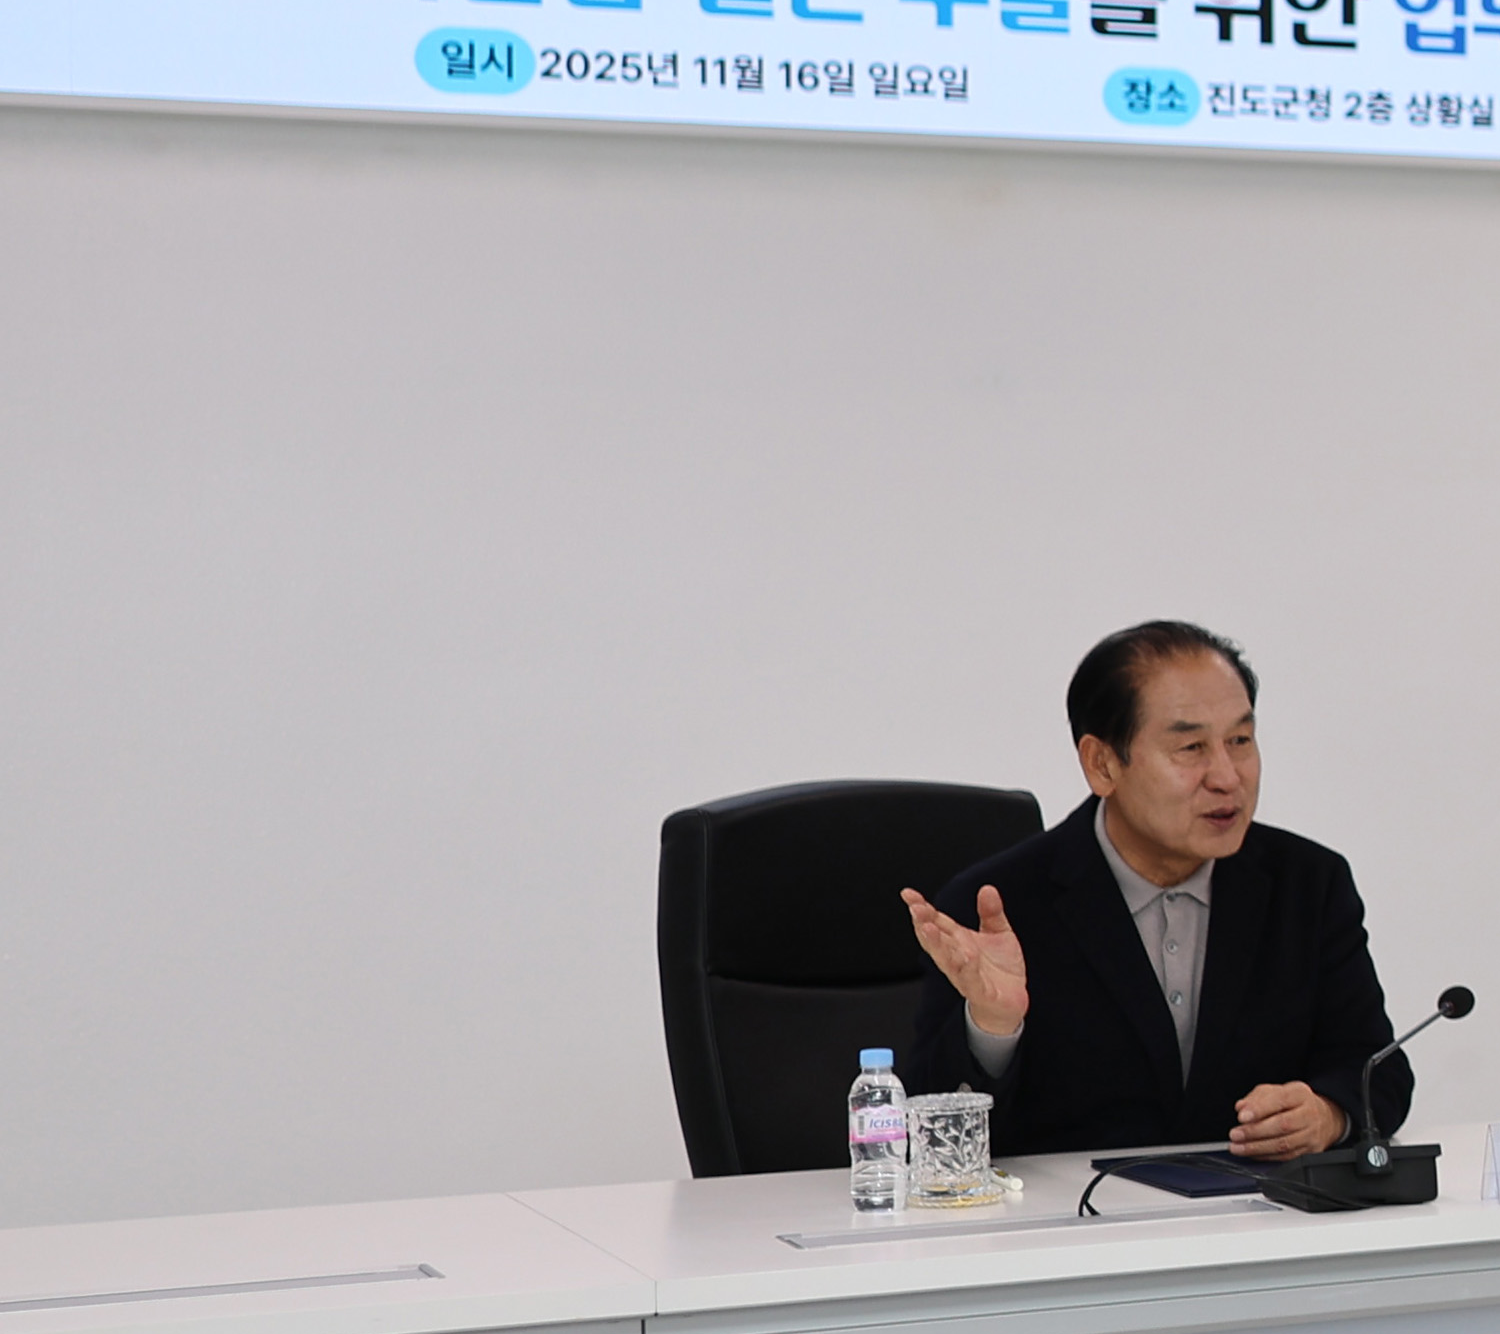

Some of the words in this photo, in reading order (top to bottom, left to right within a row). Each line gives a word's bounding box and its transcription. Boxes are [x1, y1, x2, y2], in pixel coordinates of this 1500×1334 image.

[440, 39, 516, 82] 일시
[539, 46, 679, 88] 2025년
[694, 51, 765, 93] 11월
[780, 55, 856, 97] 16일
[867, 61, 970, 103] 일요일
[1122, 78, 1189, 114] 장소
[1206, 82, 1334, 122] 진도군청
[1343, 89, 1394, 126] 2층
[1404, 90, 1496, 130] 상황실
